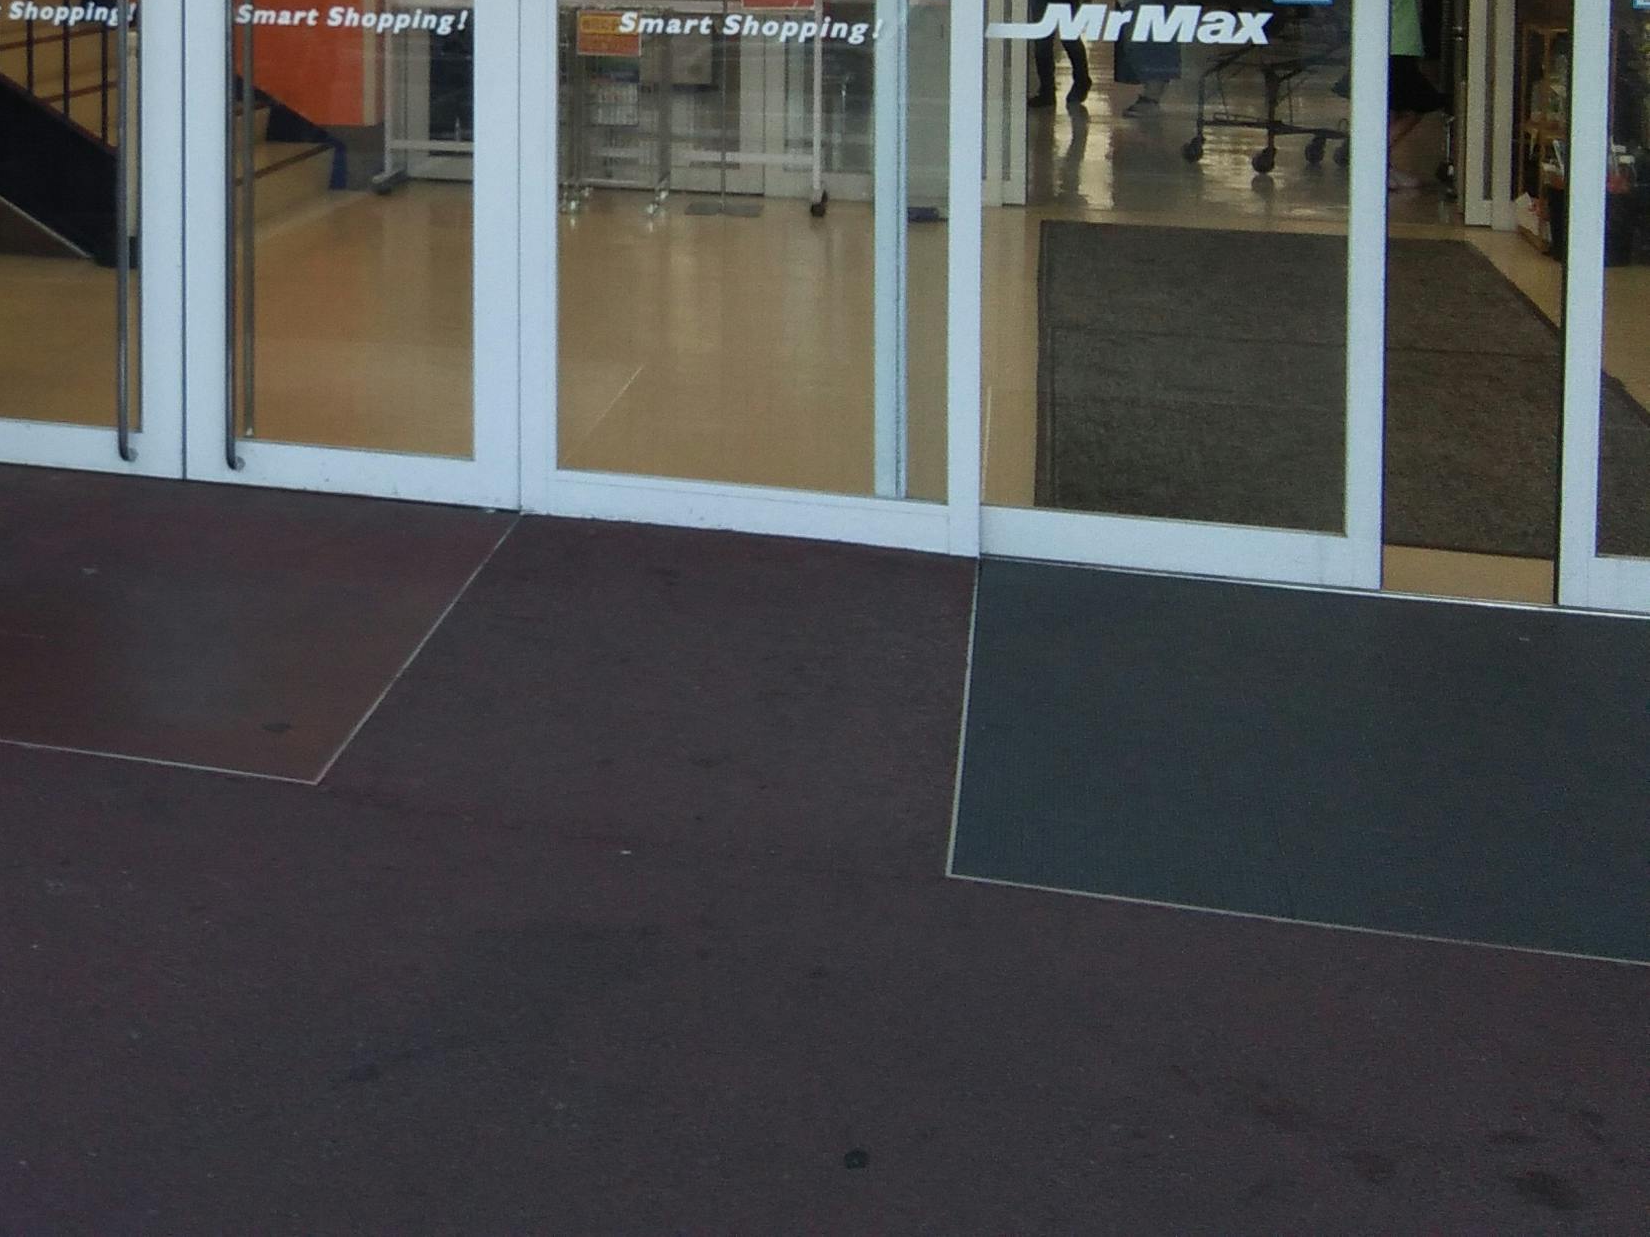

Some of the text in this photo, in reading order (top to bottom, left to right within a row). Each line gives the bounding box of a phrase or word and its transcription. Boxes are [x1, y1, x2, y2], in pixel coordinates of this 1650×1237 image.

[235, 3, 469, 36] Smart Shopping!
[618, 11, 714, 36] Smart
[722, 13, 884, 45] Shopping!
[984, 2, 1274, 45] MrMax
